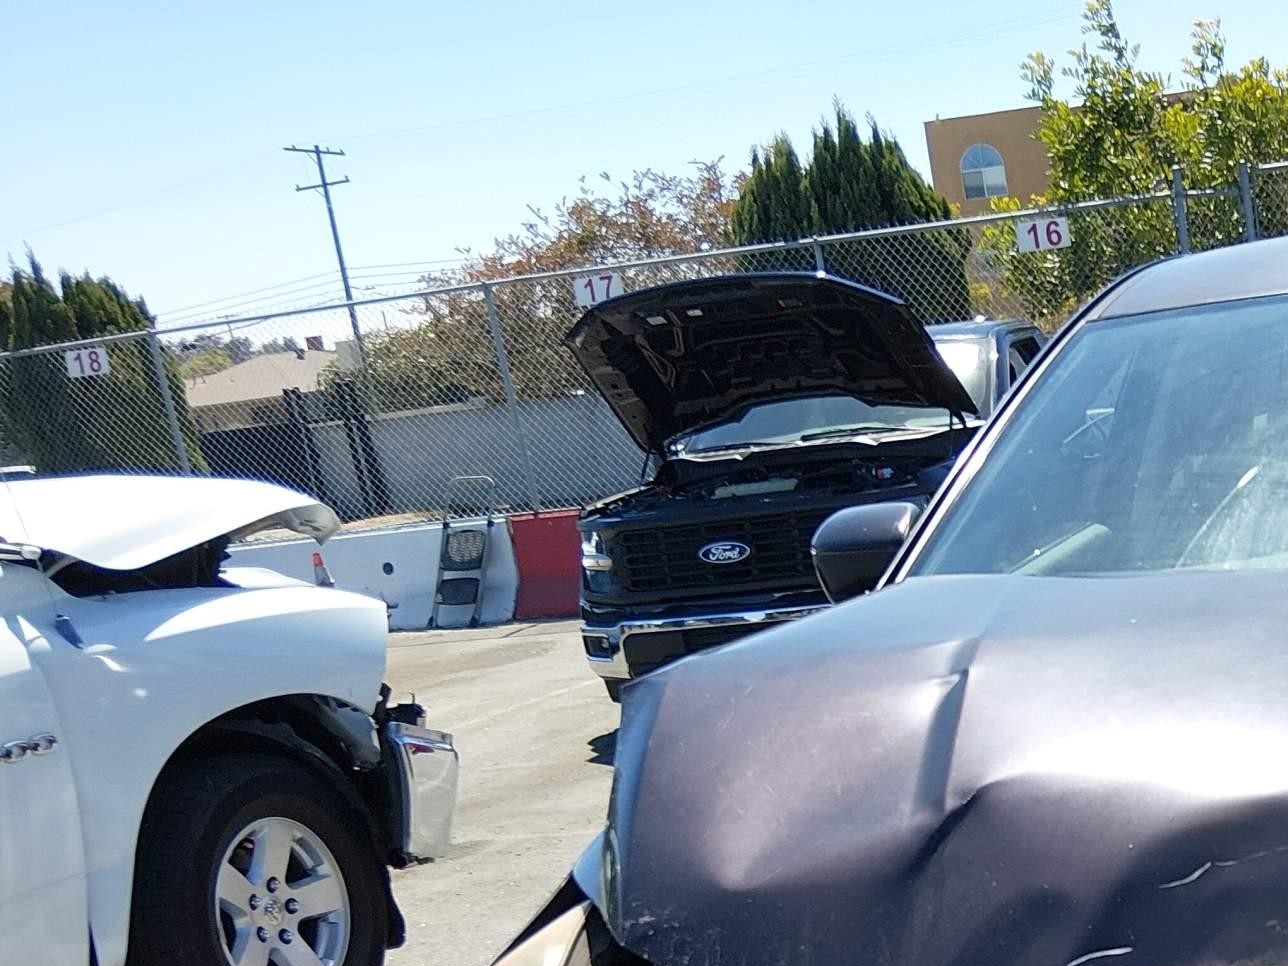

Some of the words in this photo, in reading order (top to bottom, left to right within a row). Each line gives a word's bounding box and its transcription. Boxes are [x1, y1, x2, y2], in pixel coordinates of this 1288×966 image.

[1027, 221, 1062, 249] 16
[584, 275, 613, 302] 17
[73, 351, 102, 375] 18
[709, 545, 740, 561] Ford
